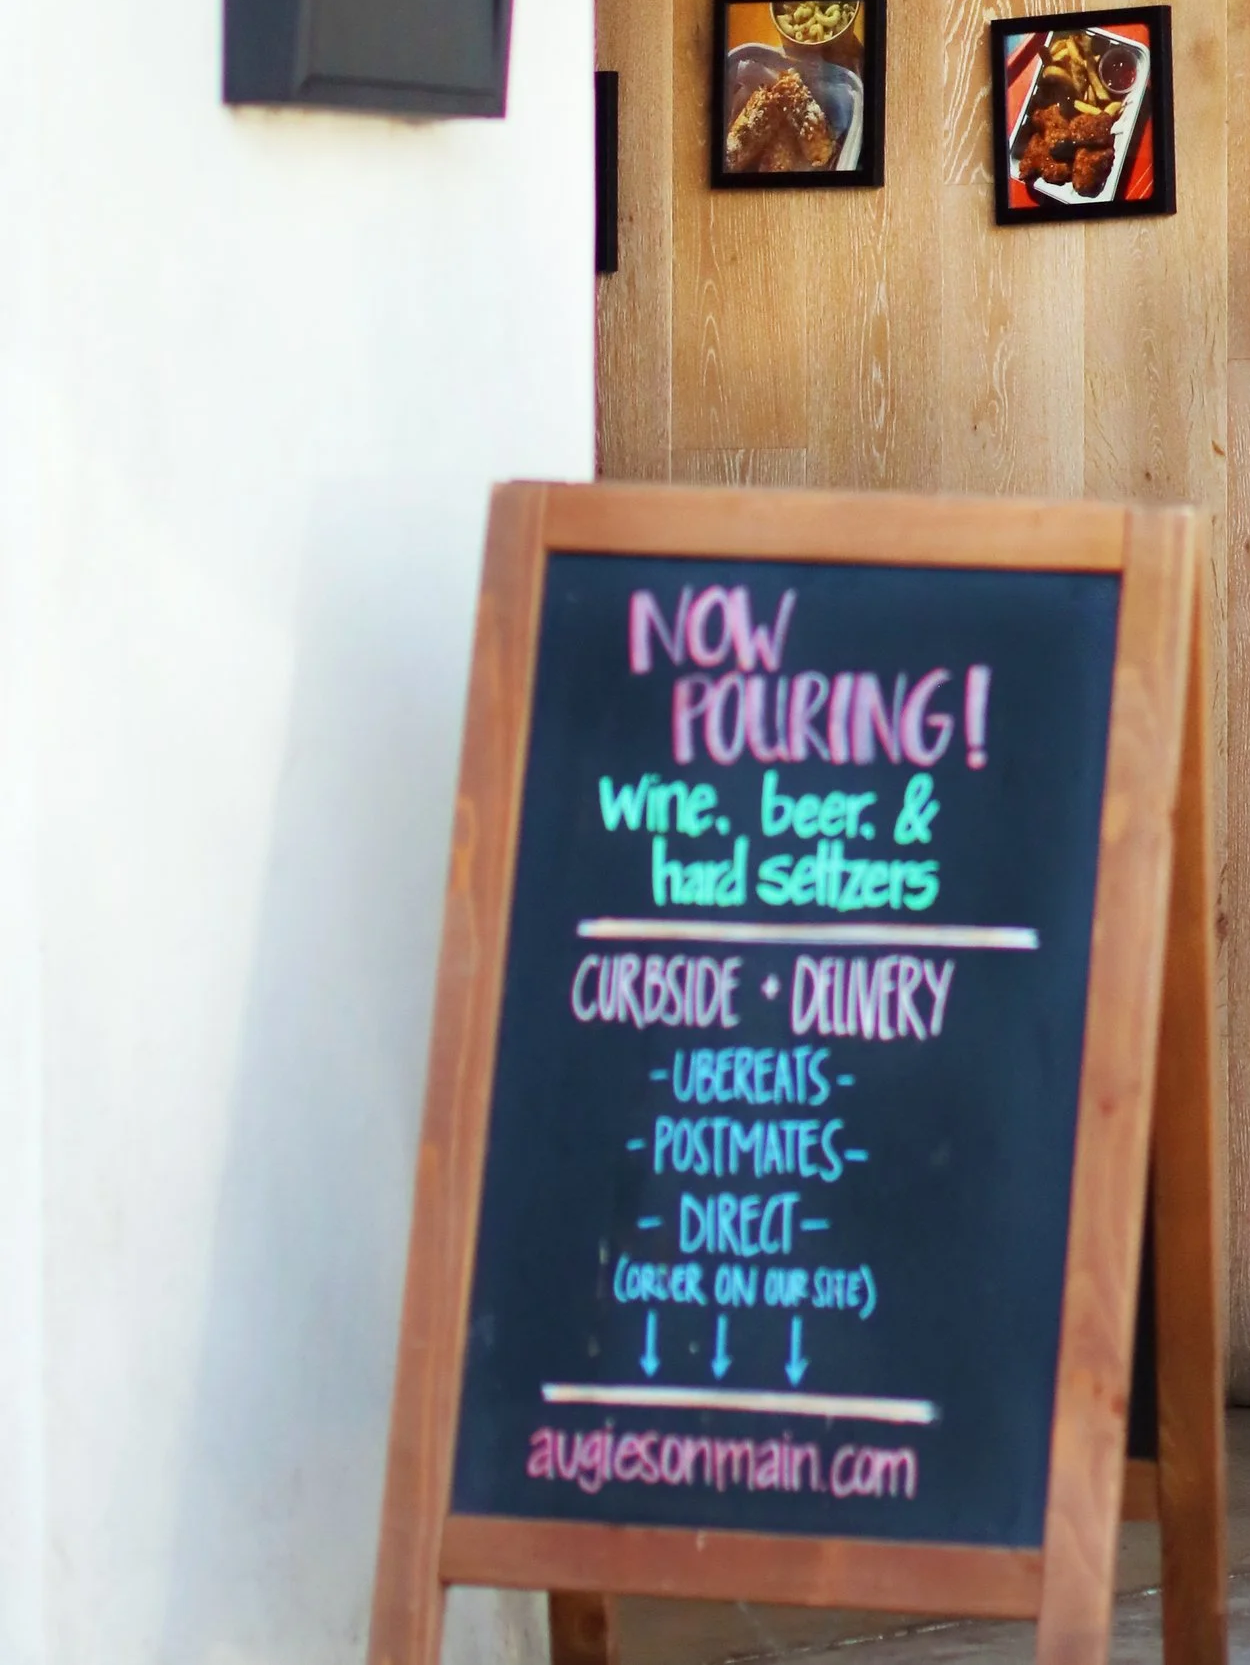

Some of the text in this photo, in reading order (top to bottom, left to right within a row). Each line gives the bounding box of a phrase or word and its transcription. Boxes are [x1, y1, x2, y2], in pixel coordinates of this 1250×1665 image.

[629, 584, 798, 675] NOW
[671, 663, 991, 769] POURING!
[893, 772, 941, 845] &
[652, 835, 941, 913] hard seltzers
[571, 953, 744, 1030] CURBSIDE
[790, 955, 956, 1041] DELIVERY
[713, 1262, 760, 1308] ON
[762, 1266, 811, 1308] OUR
[526, 1419, 918, 1500] augiesonmain.com
